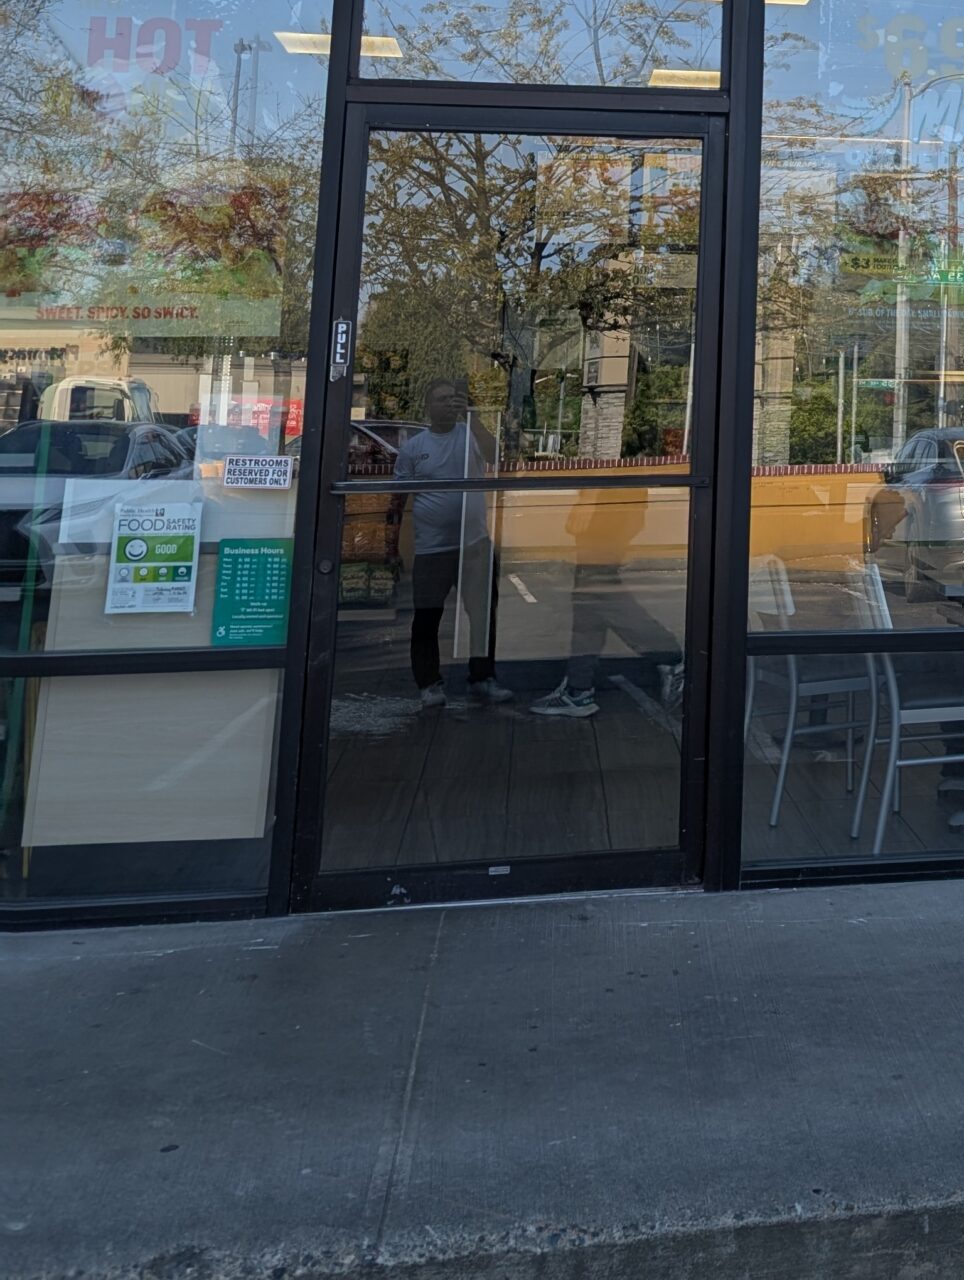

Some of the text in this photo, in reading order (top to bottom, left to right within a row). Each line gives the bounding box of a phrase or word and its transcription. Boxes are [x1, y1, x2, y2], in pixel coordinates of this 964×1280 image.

[87, 16, 224, 75] HOT
[132, 305, 150, 319] SO
[335, 323, 347, 363] PULL
[228, 458, 289, 468] RESTROOMS
[226, 467, 288, 477] RESERVED FOR
[225, 477, 288, 486] CUSTOMERS ONLY
[118, 518, 165, 531] FOOD
[155, 544, 177, 554] GOOD
[260, 547, 284, 555] Hours
